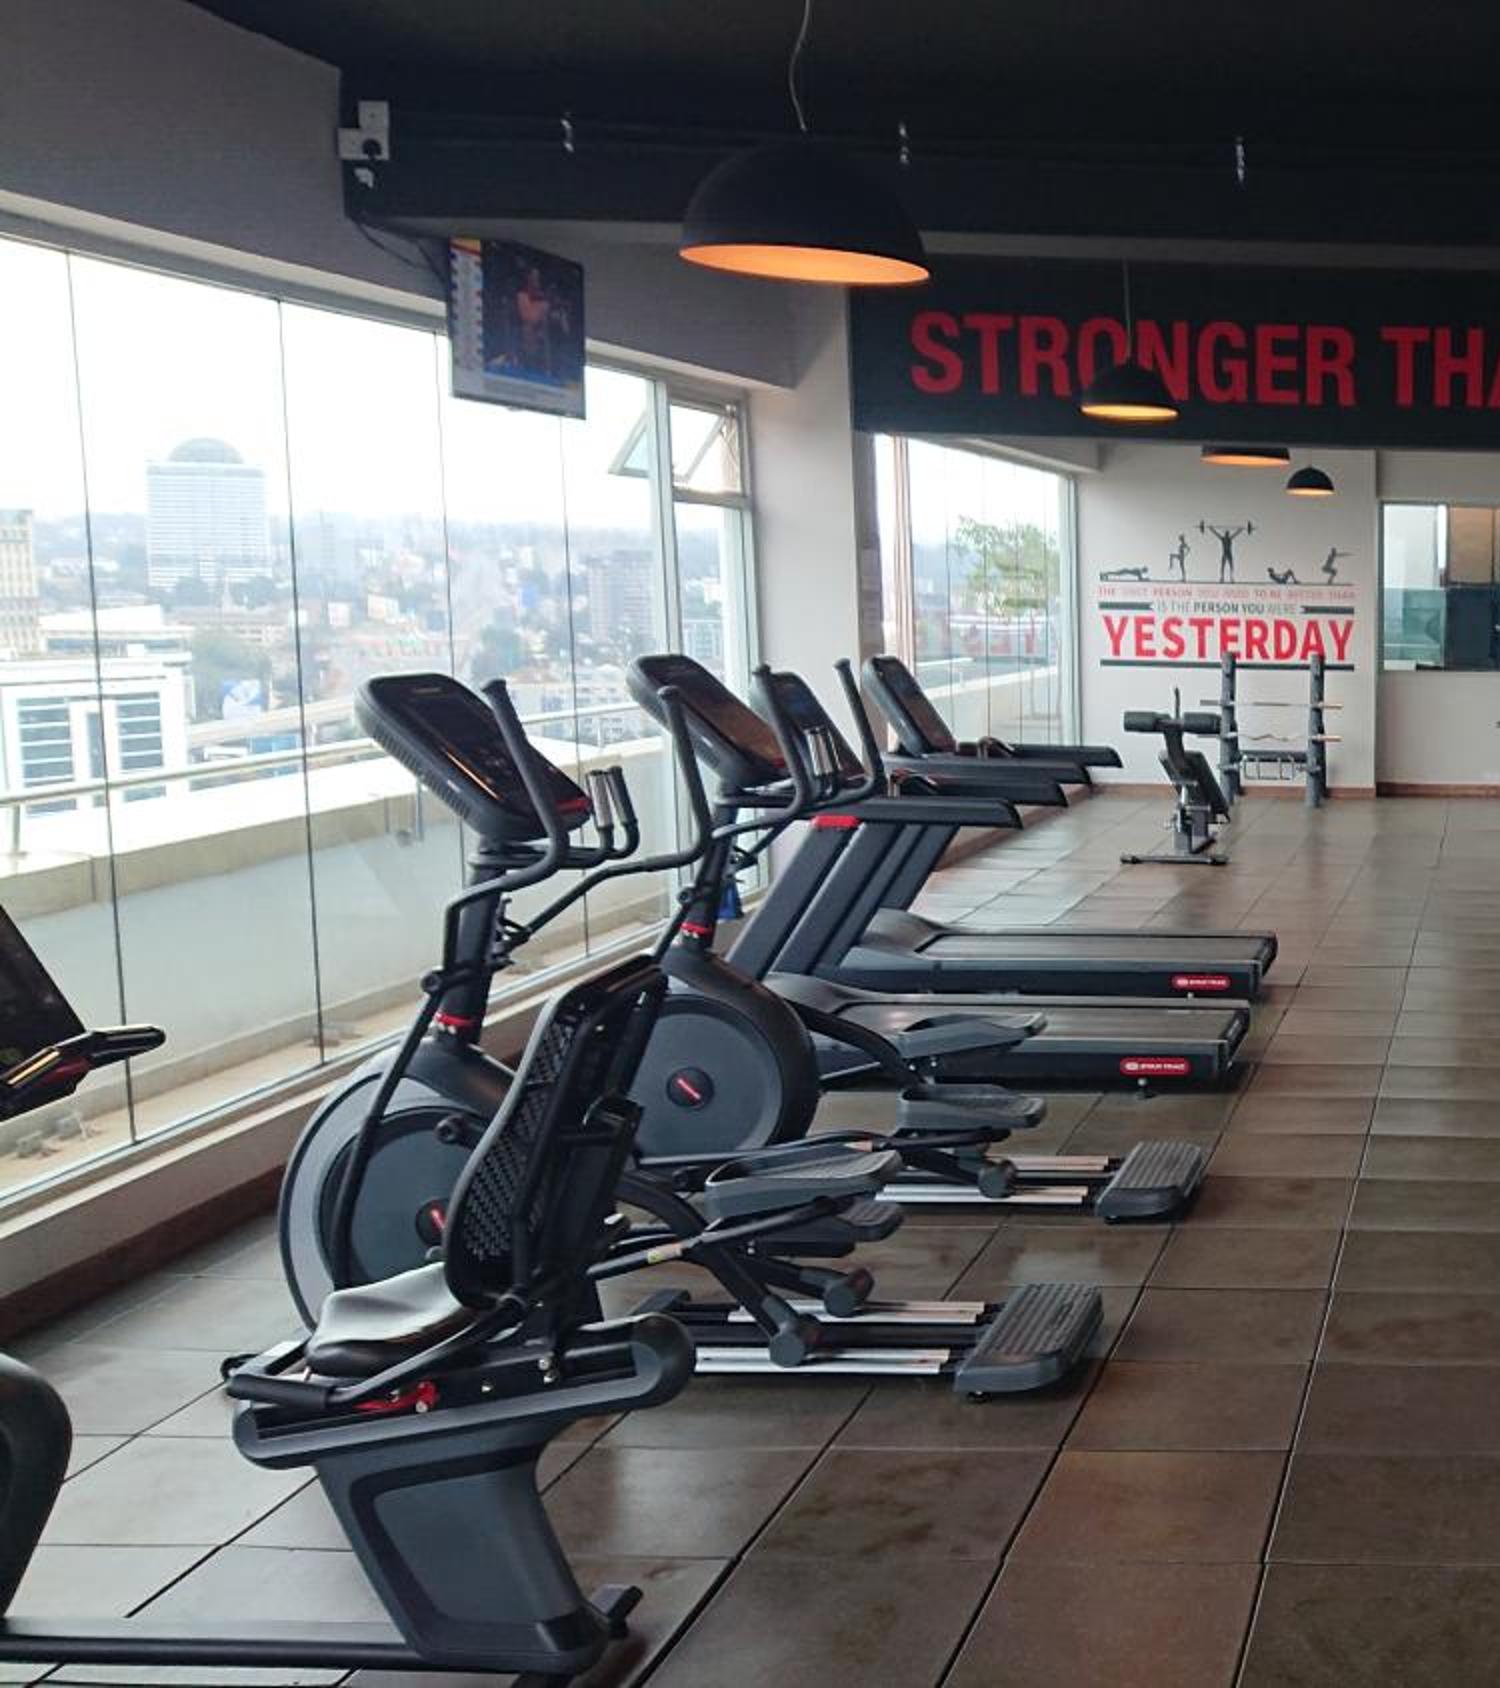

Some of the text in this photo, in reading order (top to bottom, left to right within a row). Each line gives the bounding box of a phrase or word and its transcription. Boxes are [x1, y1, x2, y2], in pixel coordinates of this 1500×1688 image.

[911, 312, 1355, 408] STRONGER
[1193, 601, 1239, 614] PERSON
[1242, 602, 1265, 615] YOU
[1102, 615, 1355, 660] YESTERDAY
